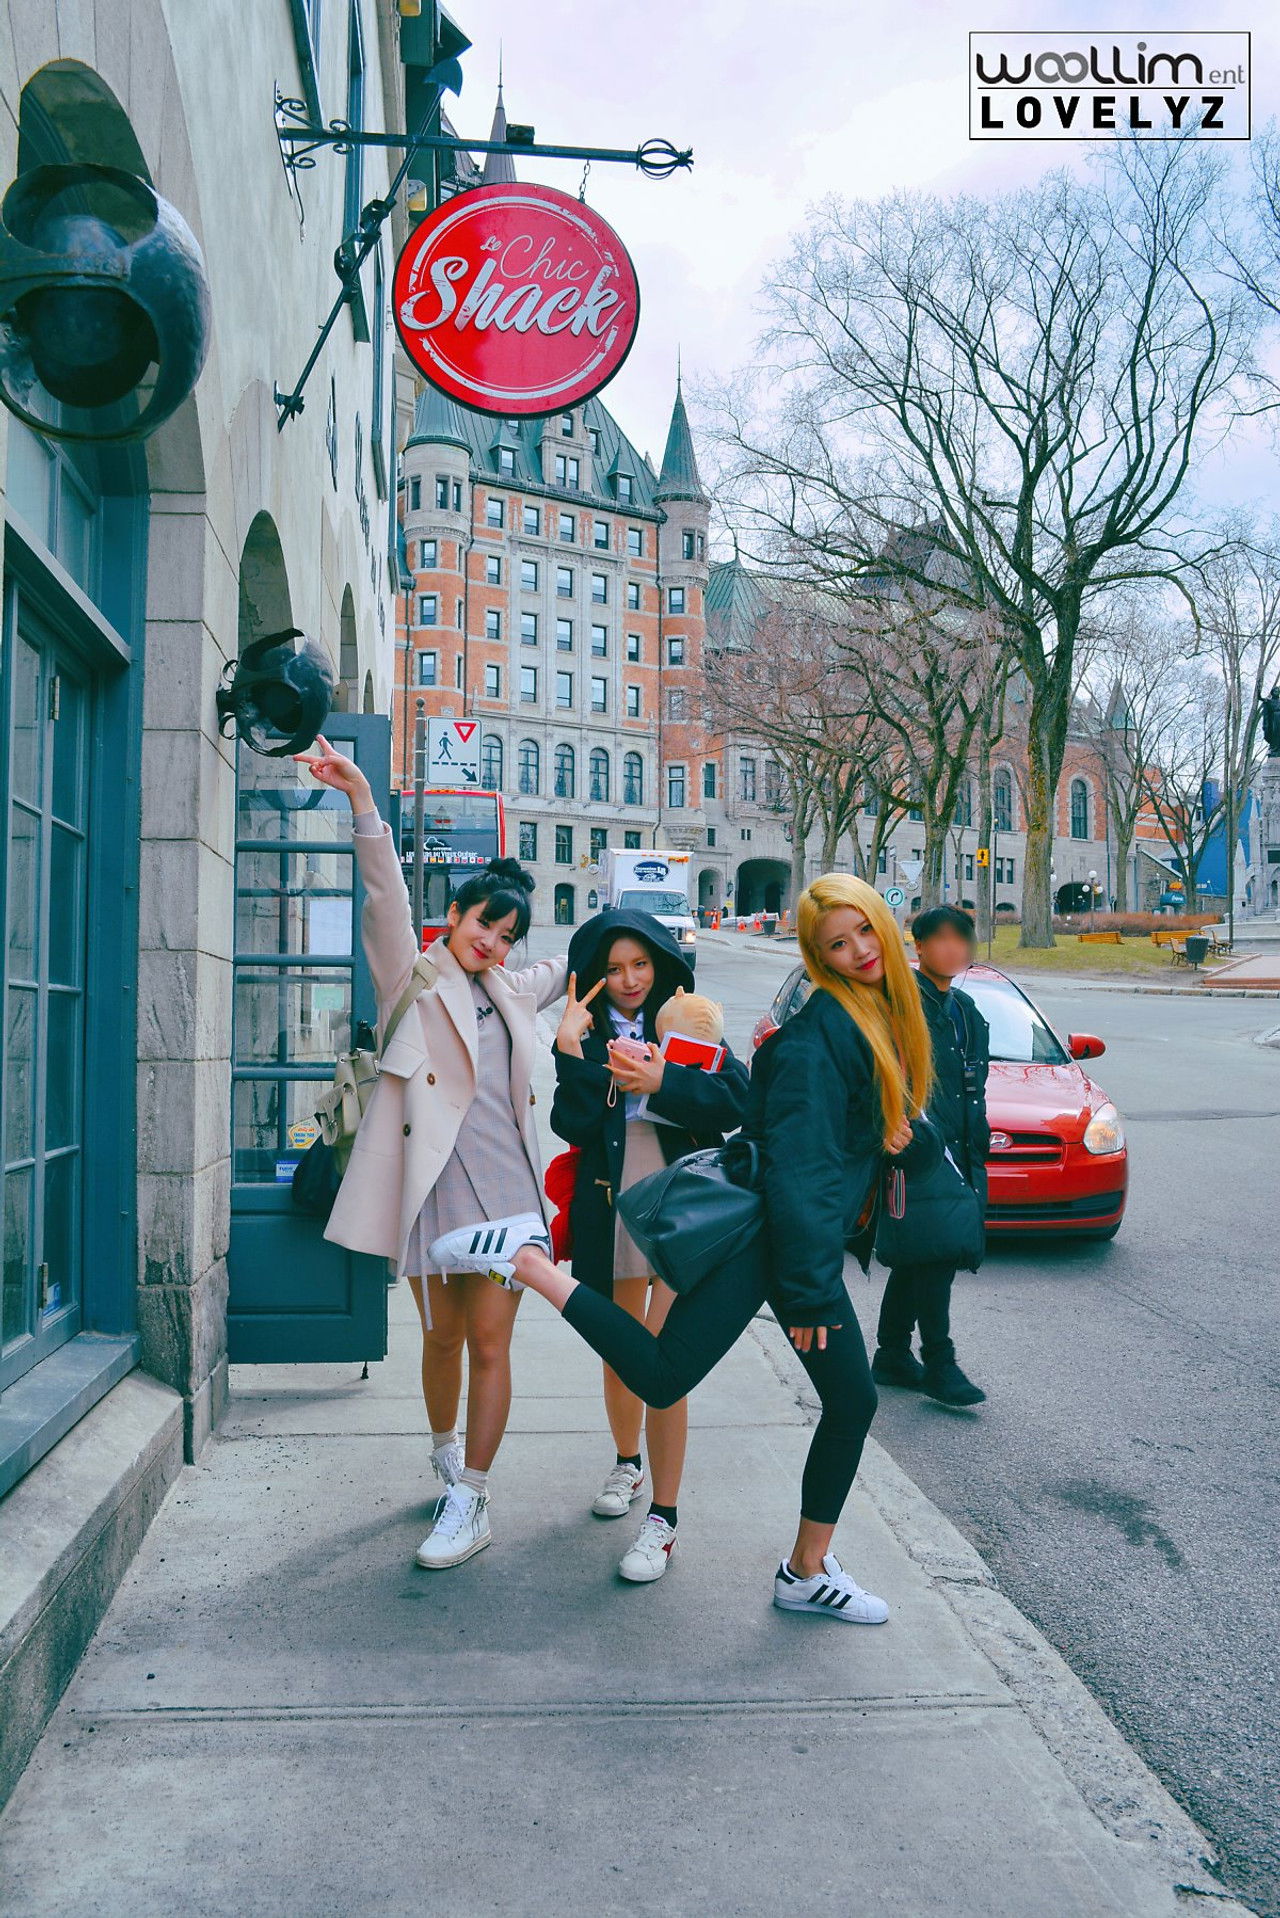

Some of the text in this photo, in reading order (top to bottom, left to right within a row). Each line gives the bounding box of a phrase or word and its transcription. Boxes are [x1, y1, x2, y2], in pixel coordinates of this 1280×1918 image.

[480, 234, 590, 281] Le Chic
[400, 256, 626, 337] Shack
